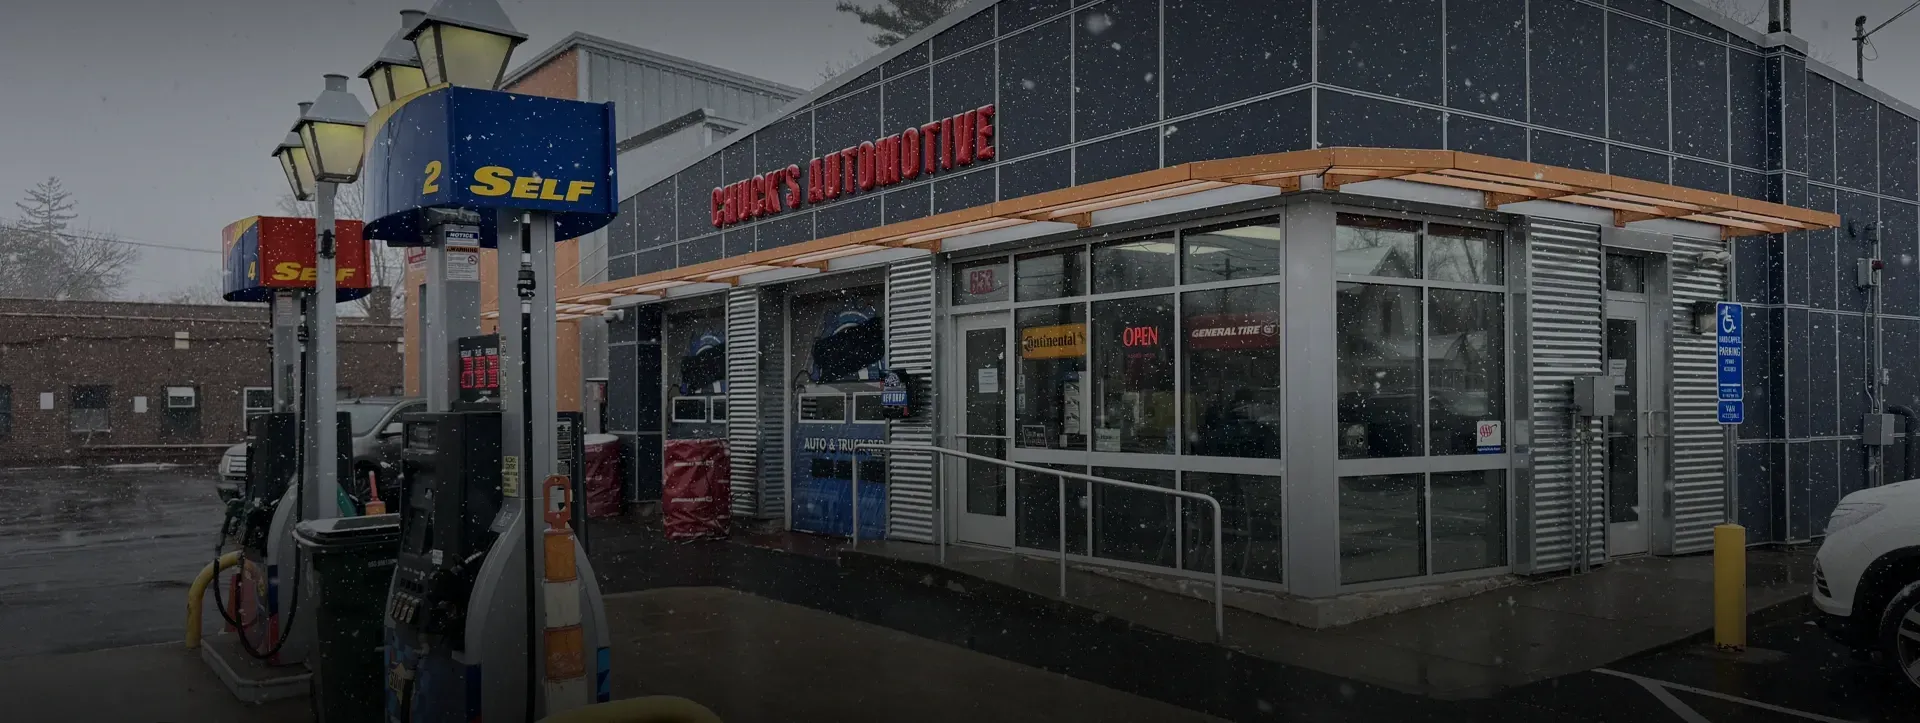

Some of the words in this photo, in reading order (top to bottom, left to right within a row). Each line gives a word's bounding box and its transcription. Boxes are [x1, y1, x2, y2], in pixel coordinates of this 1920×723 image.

[711, 164, 800, 228] CHUCK'S
[808, 104, 995, 204] AUTOMOTIVE
[423, 160, 442, 195] 2
[469, 165, 595, 202] SELF
[247, 260, 257, 281] 4
[271, 261, 356, 282] SEF
[1023, 331, 1077, 352] Continental
[1122, 325, 1159, 347] OPEN
[1191, 326, 1237, 338] GENERAL
[1237, 325, 1261, 336] TIRE
[1719, 346, 1741, 357] PARKING
[1725, 404, 1736, 412] VAN
[804, 437, 827, 451] AUTO
[829, 439, 836, 452] &
